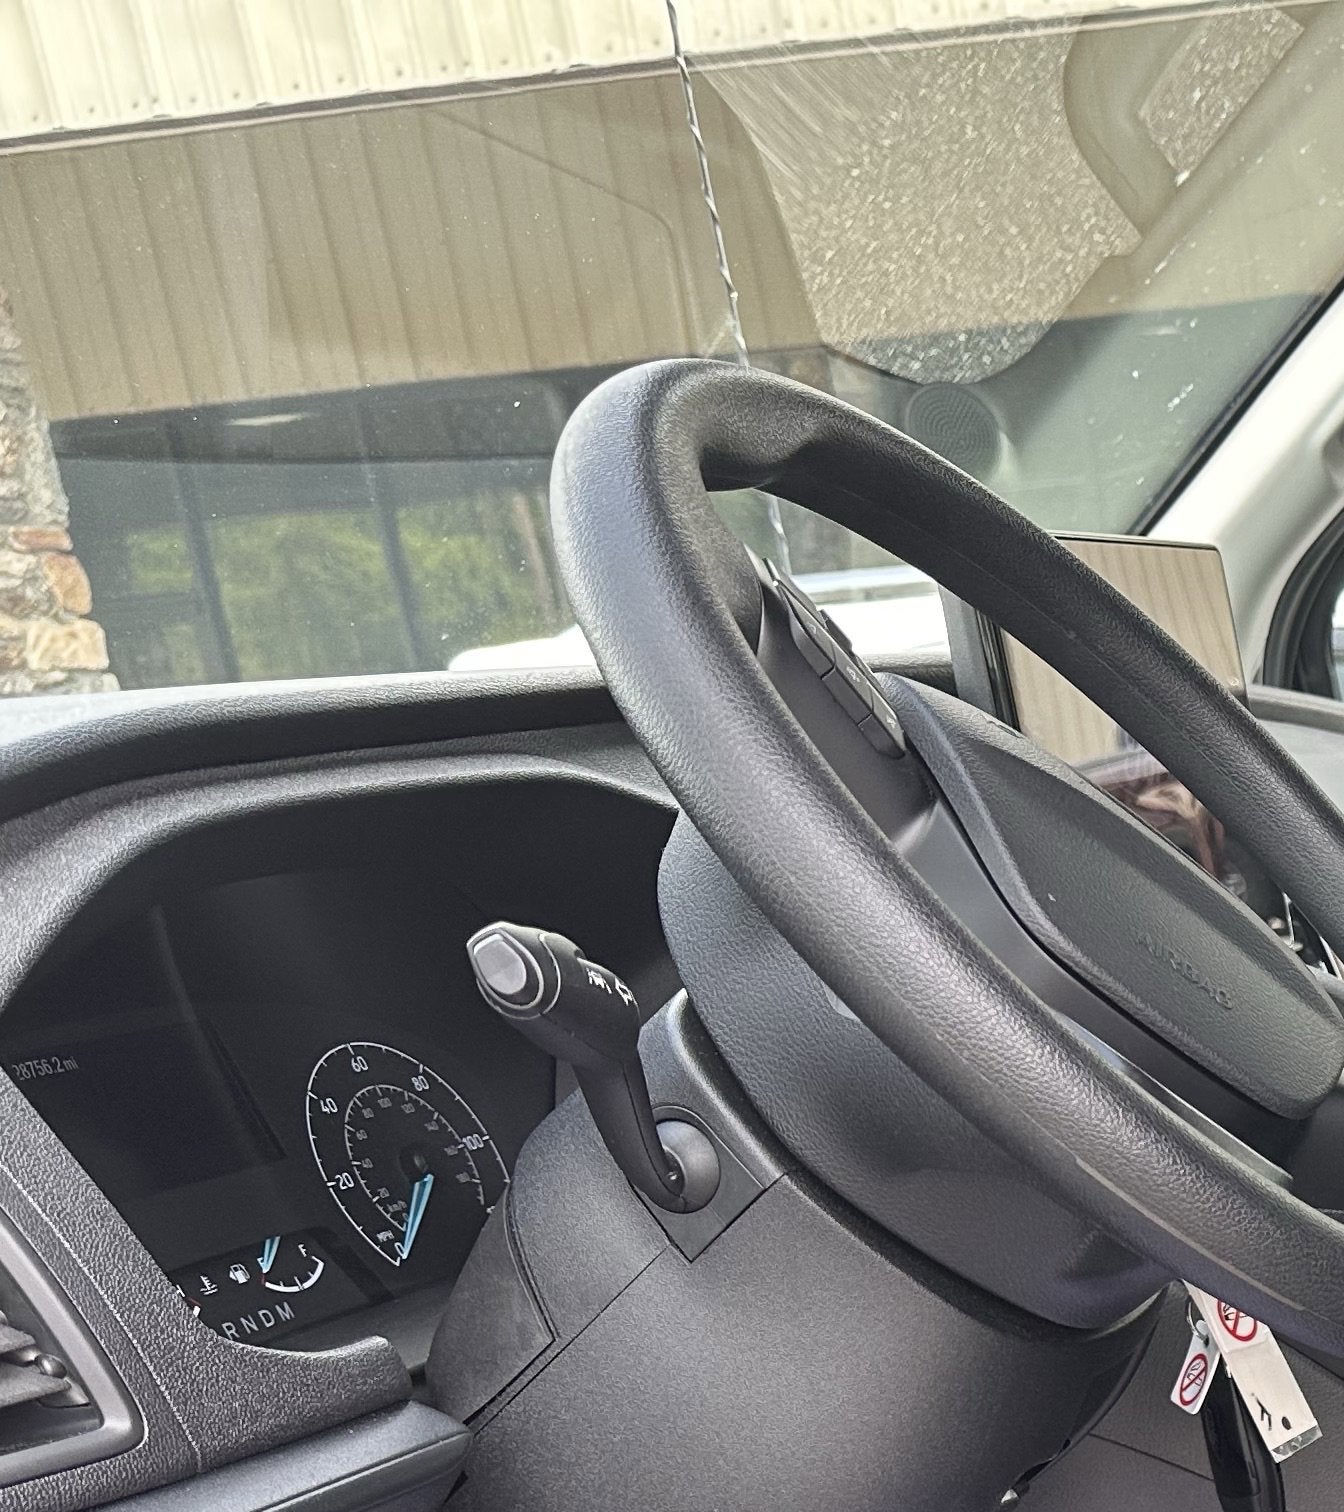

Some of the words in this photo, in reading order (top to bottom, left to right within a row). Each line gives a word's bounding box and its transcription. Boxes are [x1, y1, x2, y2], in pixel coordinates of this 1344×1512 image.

[351, 1056, 368, 1072] 60
[411, 1075, 430, 1091] 80
[320, 1097, 338, 1114] 40
[463, 1134, 484, 1150] 100
[335, 1172, 354, 1190] 20
[298, 1243, 307, 1257] F
